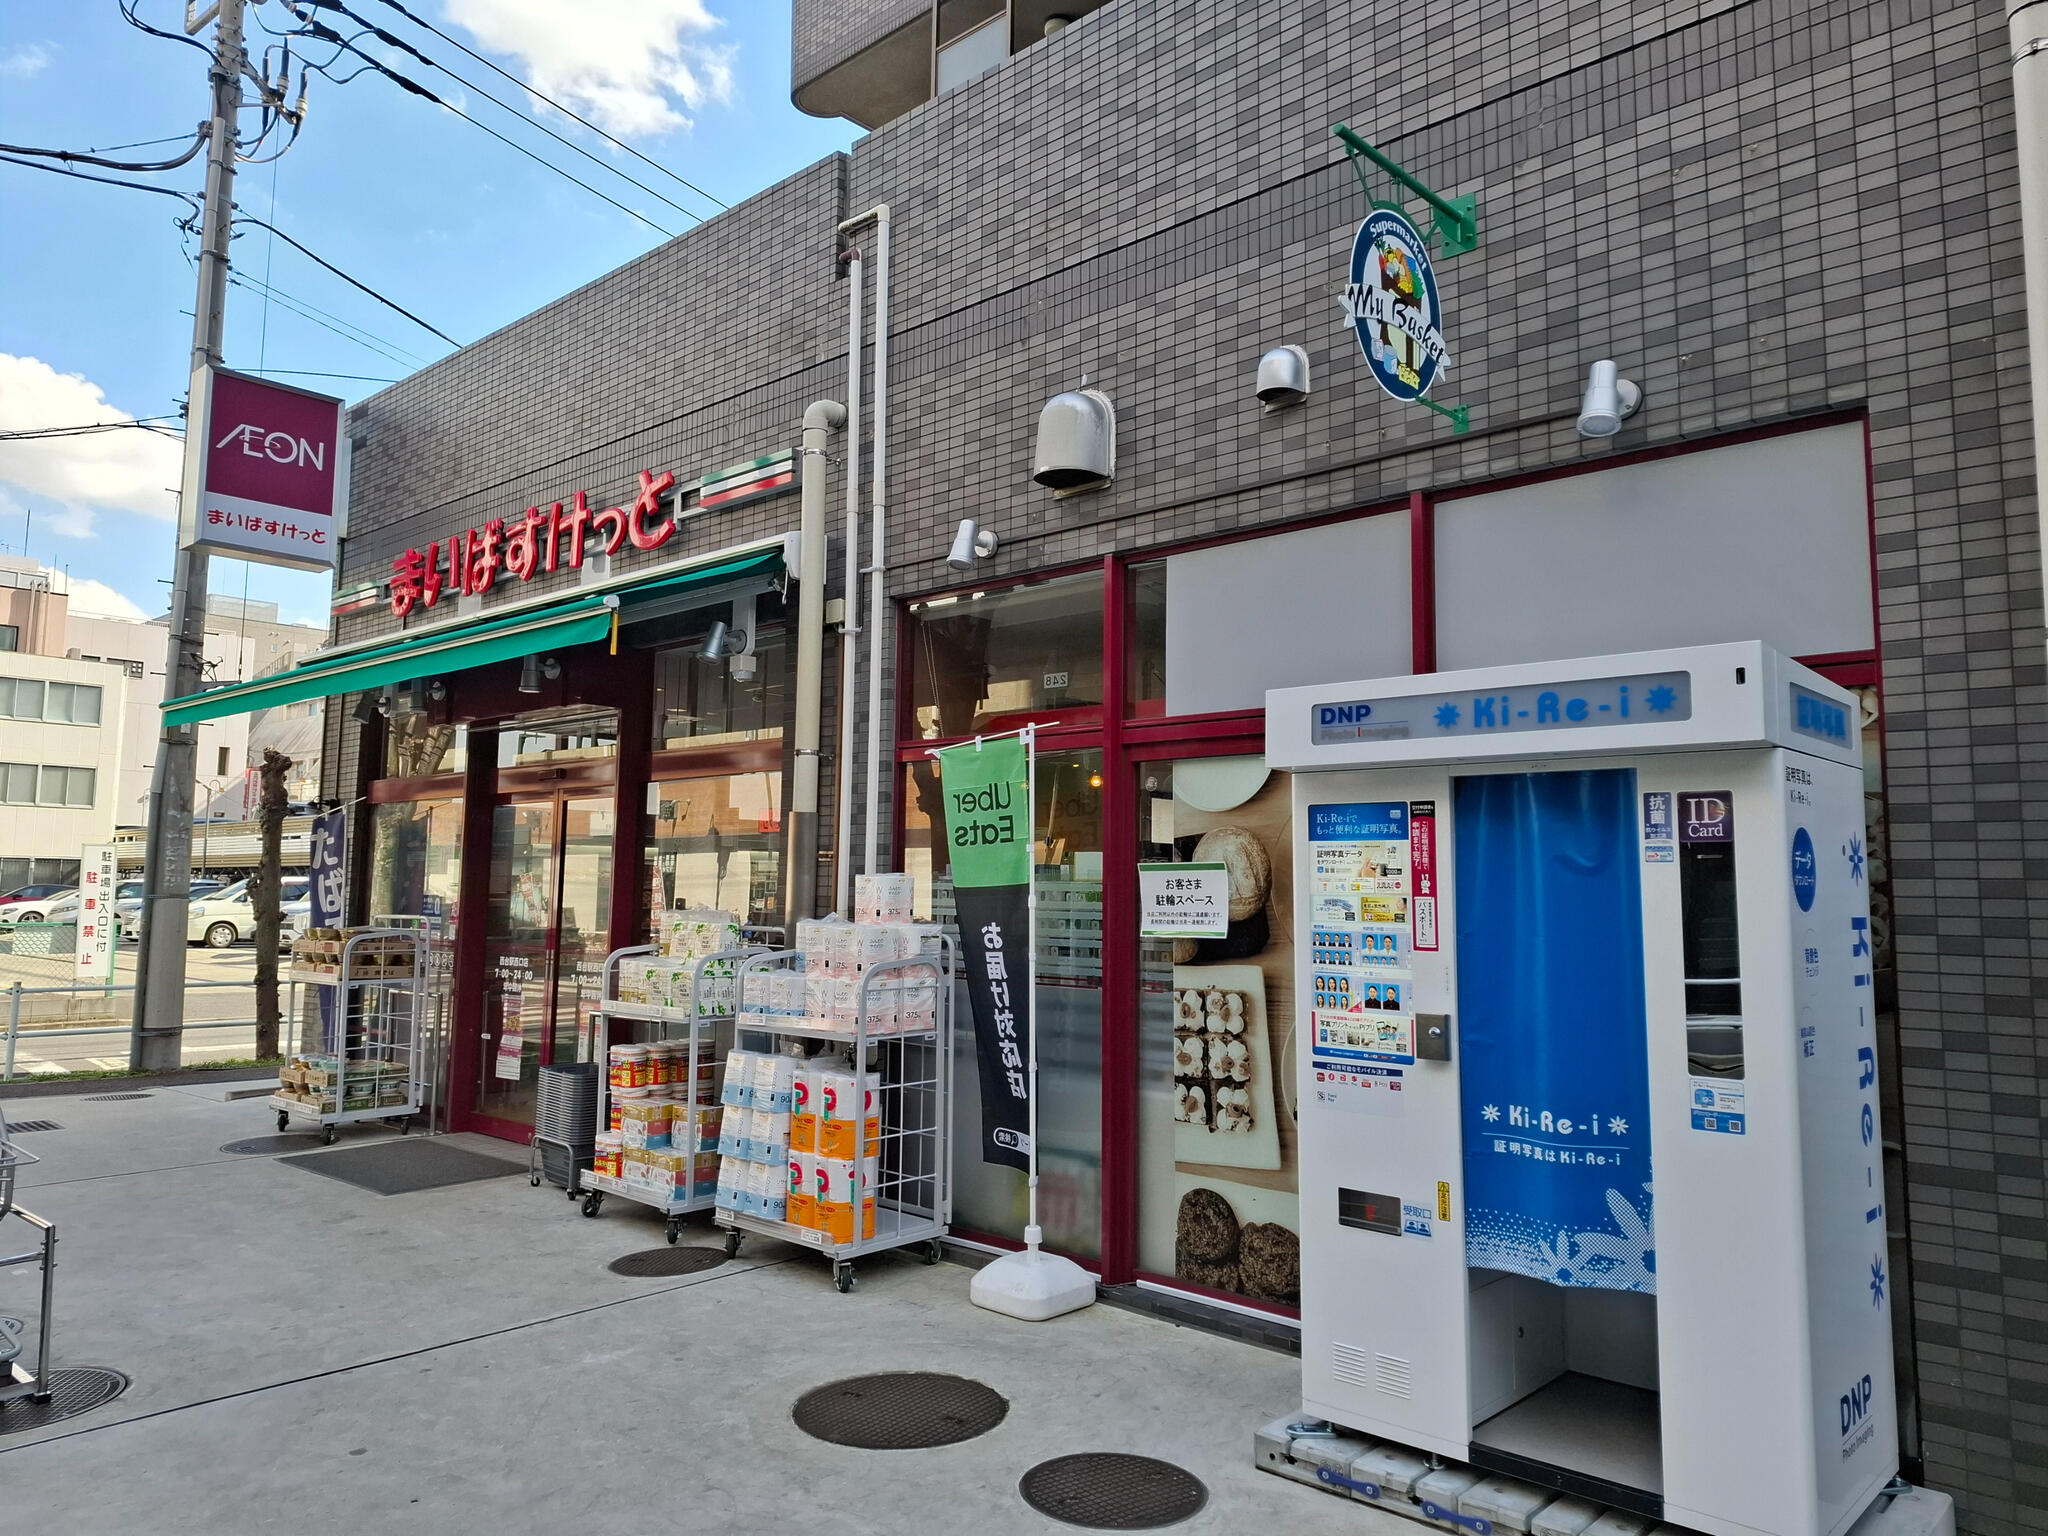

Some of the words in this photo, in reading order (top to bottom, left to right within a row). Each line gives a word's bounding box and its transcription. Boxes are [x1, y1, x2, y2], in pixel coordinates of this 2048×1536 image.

[1369, 219, 1428, 273] Supermarket
[1348, 284, 1384, 323] My
[1392, 298, 1446, 367] Basket
[207, 509, 326, 544] まいばすけっと
[390, 469, 676, 618] まいばすけっと
[1321, 704, 1371, 725] DNP
[1474, 686, 1630, 727] Ki-Re-i
[1316, 813, 1358, 824] Ki-Re-iで
[1649, 795, 1666, 825] 抗菌
[1686, 798, 1725, 824] ID
[1316, 823, 1402, 835] もっと便利な証明写真。
[1688, 823, 1724, 838] Card
[311, 828, 345, 929] たば
[1166, 878, 1202, 890] お客さま
[96, 851, 112, 953] 駐車場出入口に付
[1156, 894, 1214, 907] 駐輪スペース
[80, 871, 98, 966] 駐車禁止
[1851, 917, 1882, 1224] Ki-Re-i
[1509, 1105, 1599, 1136] Ki-Re-i
[1494, 1140, 1555, 1162] 証明写真は
[1403, 1205, 1432, 1219] 受取口
[1840, 1374, 1871, 1437] DNP
